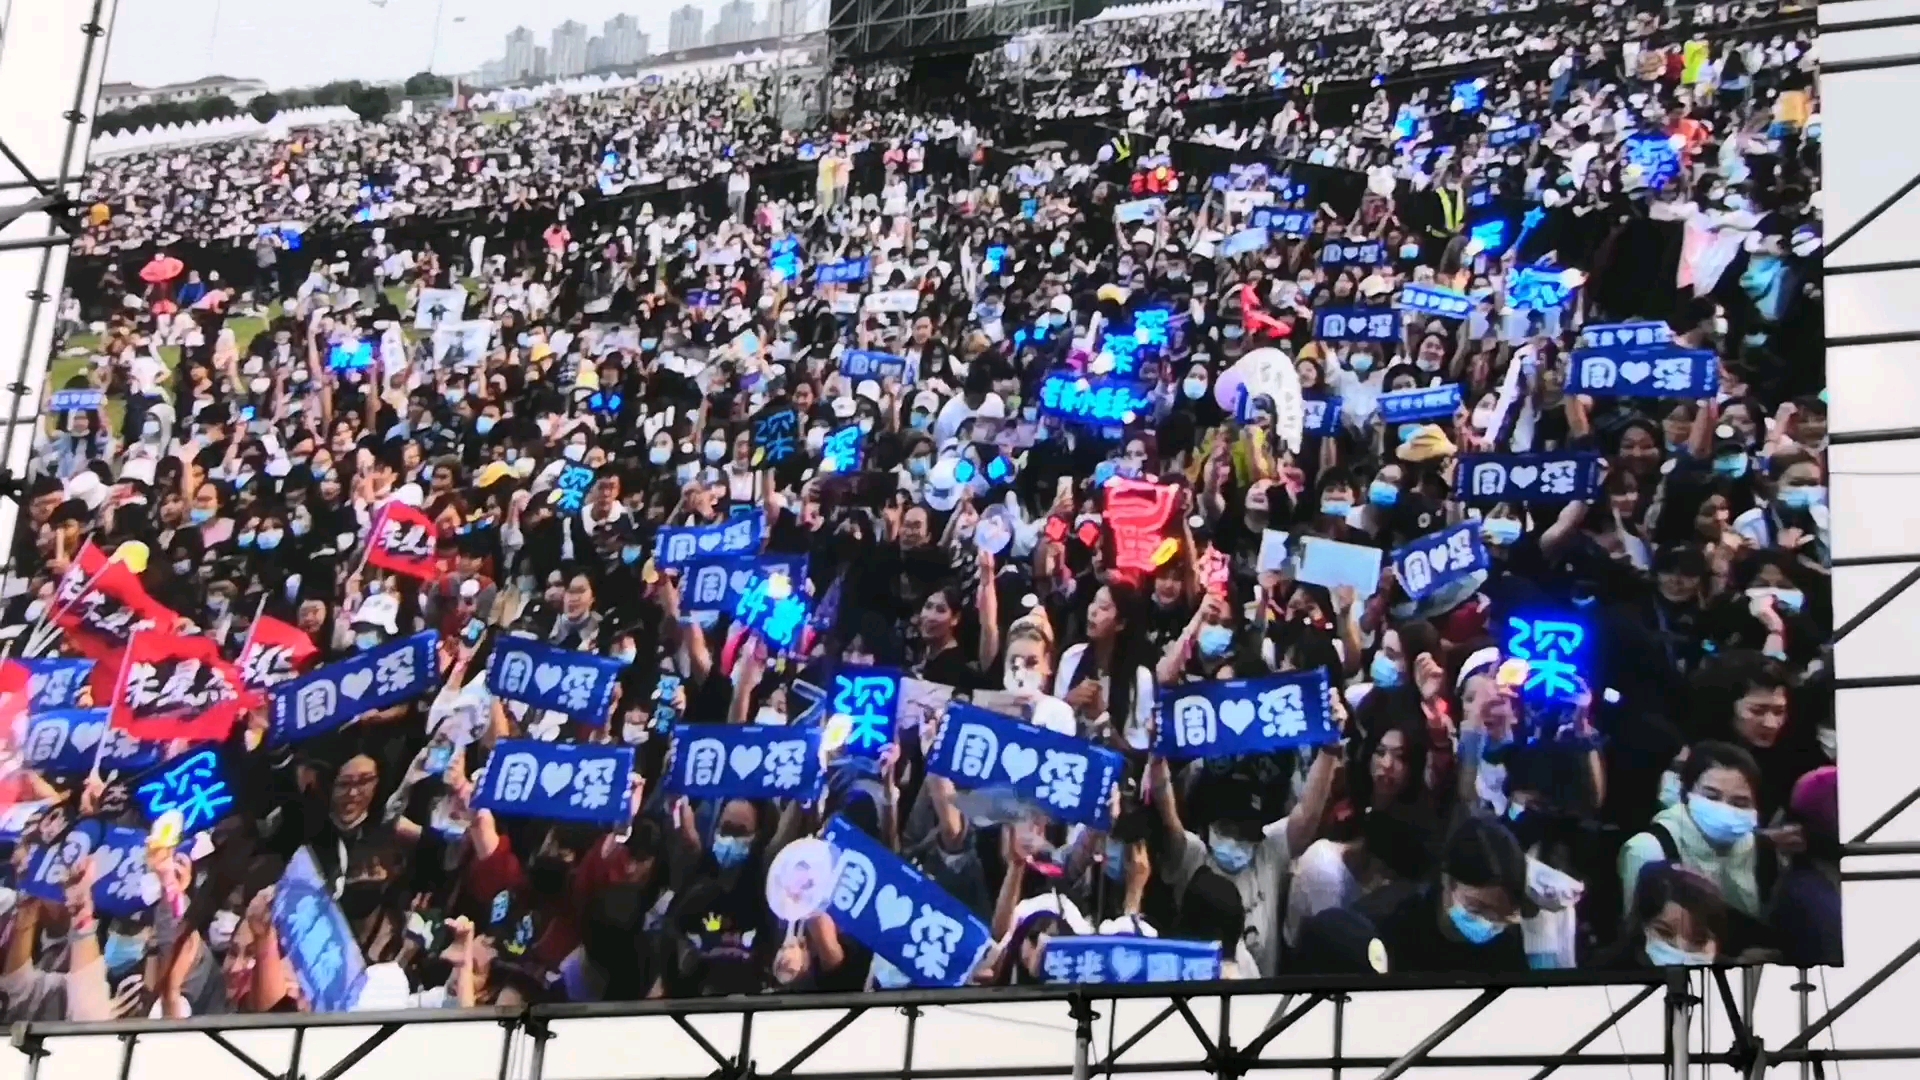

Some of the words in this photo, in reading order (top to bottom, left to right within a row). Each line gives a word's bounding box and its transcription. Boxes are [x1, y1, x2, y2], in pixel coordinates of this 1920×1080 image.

[1581, 357, 1692, 390] 周深
[755, 409, 796, 460] 深
[824, 426, 859, 471] 深
[558, 464, 594, 509] 深
[1472, 460, 1577, 495] 周深
[667, 520, 751, 563] 周深
[1404, 528, 1476, 592] 周深
[499, 651, 599, 710] 周深
[1508, 616, 1584, 697] 深
[297, 646, 415, 729] 周深
[833, 674, 894, 748] 深
[1173, 684, 1308, 748] 周深
[138, 751, 233, 830] 深
[494, 752, 617, 810] 周深
[685, 738, 807, 790] 周深
[951, 723, 1088, 809] 周深
[831, 848, 965, 981] 周深
